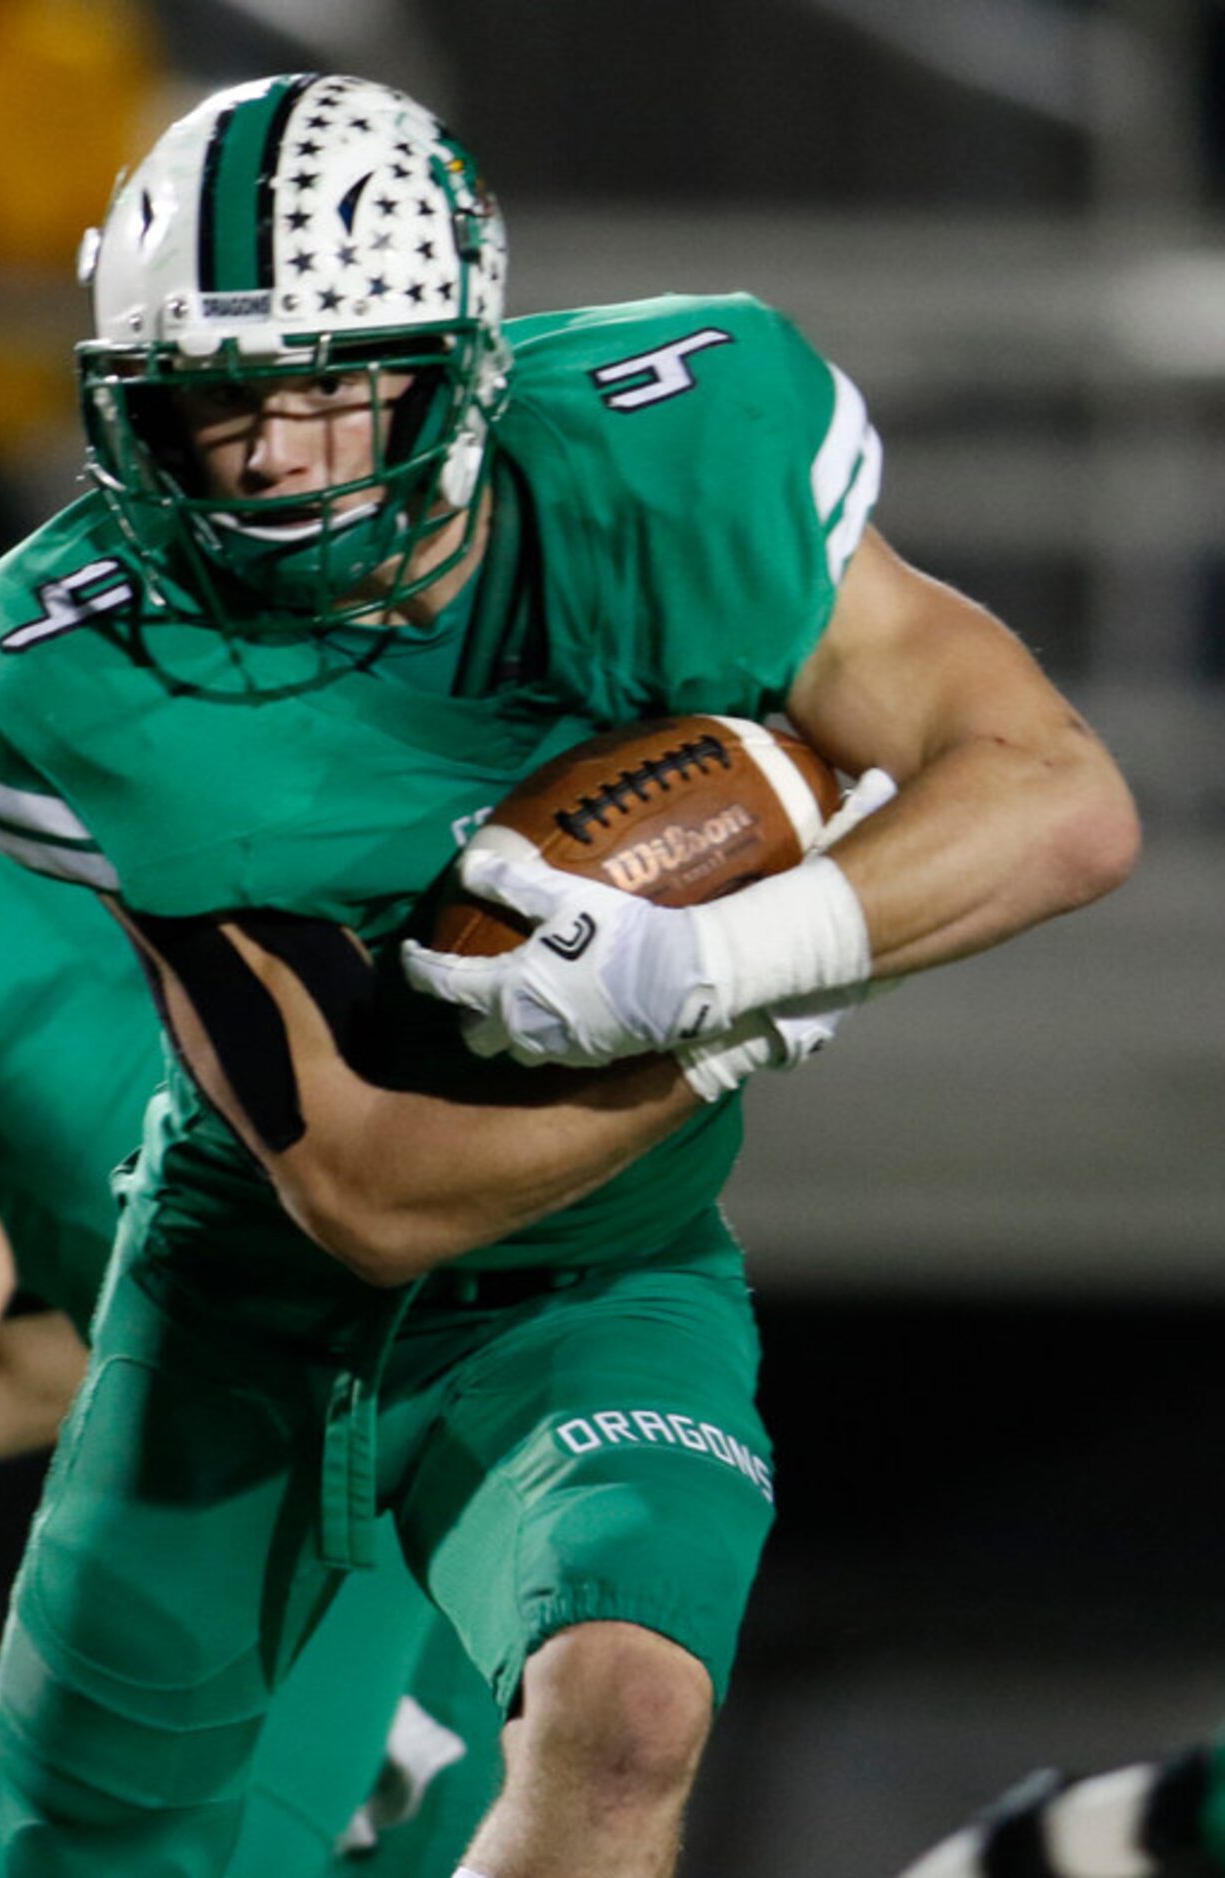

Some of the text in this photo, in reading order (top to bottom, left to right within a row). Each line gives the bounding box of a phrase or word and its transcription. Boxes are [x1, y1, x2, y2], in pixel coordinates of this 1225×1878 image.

[590, 327, 734, 413] 4
[601, 803, 753, 892] Wilson
[556, 1410, 774, 1504] DRAGONS
